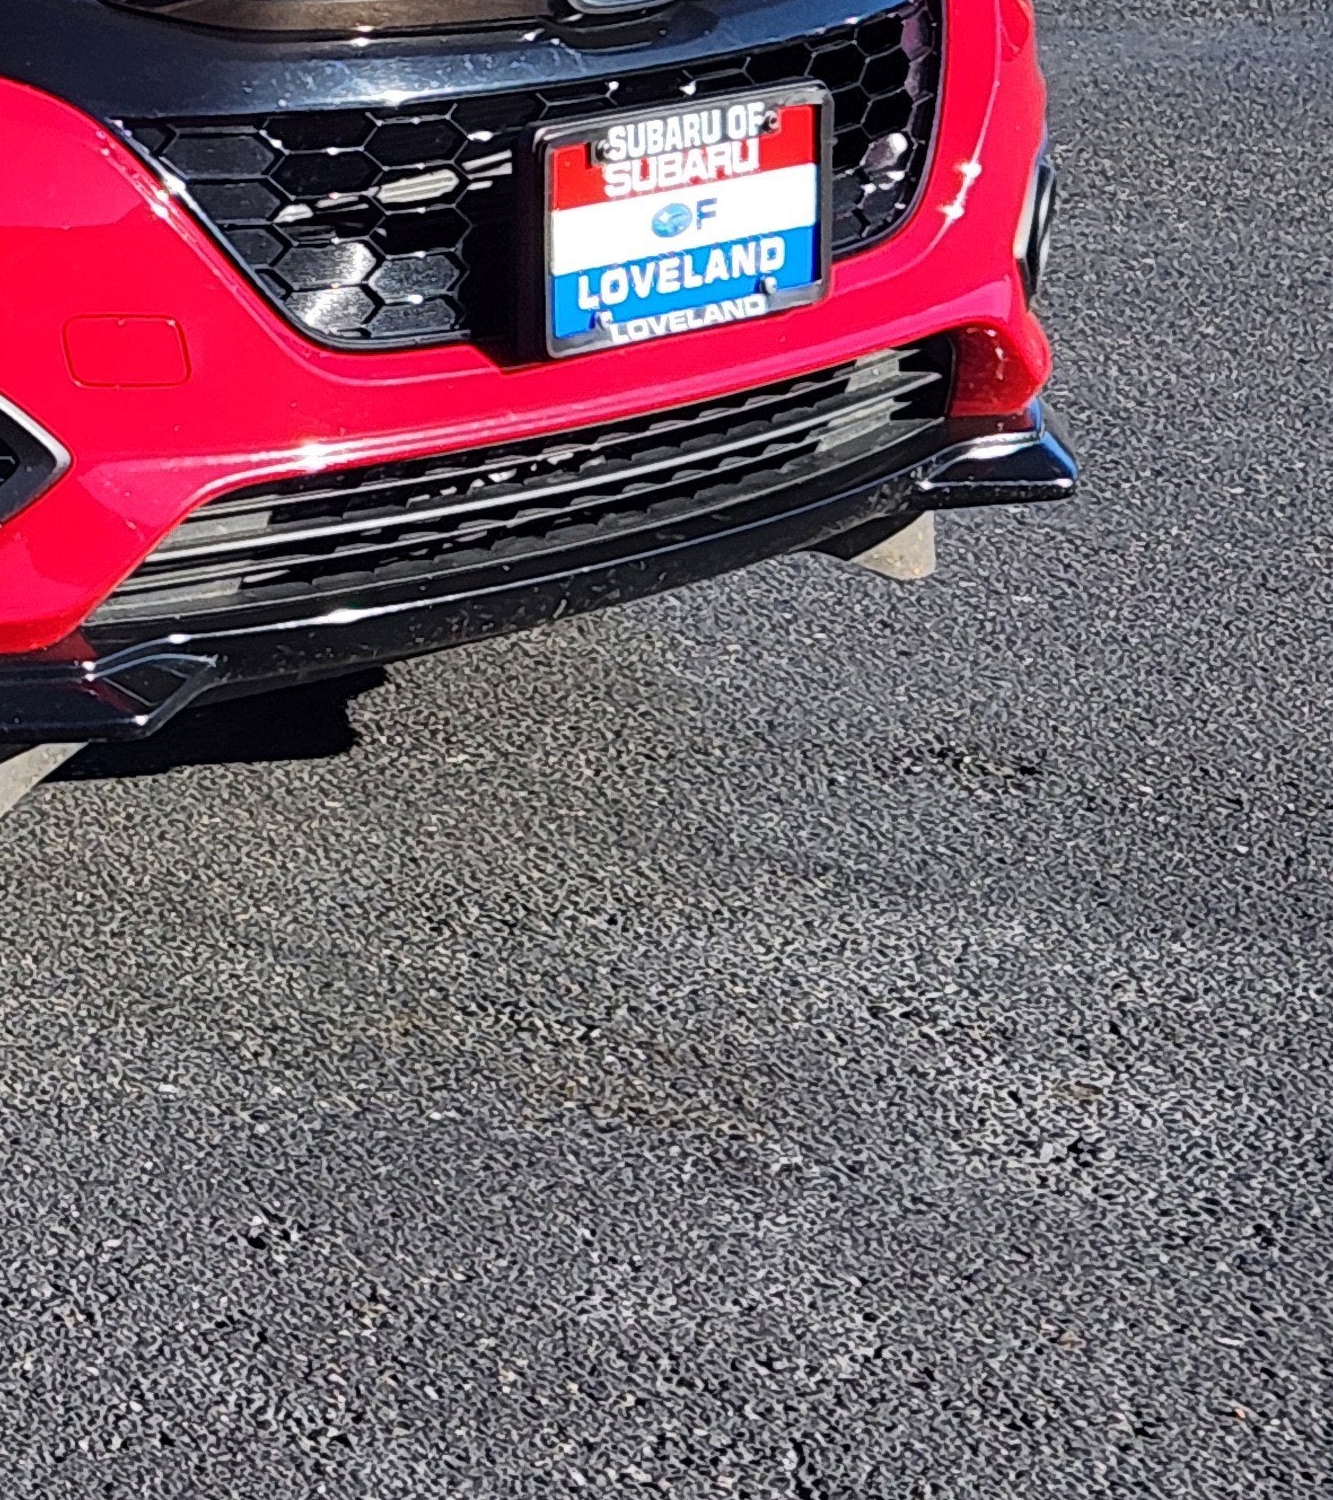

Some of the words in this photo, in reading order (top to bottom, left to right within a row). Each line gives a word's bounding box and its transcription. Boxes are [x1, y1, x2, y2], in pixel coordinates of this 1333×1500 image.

[606, 108, 723, 162] SUBARU
[726, 101, 765, 139] OF
[603, 139, 760, 198] SUBARU
[576, 236, 786, 311] LOVELAND
[608, 293, 768, 344] LOVELAND
